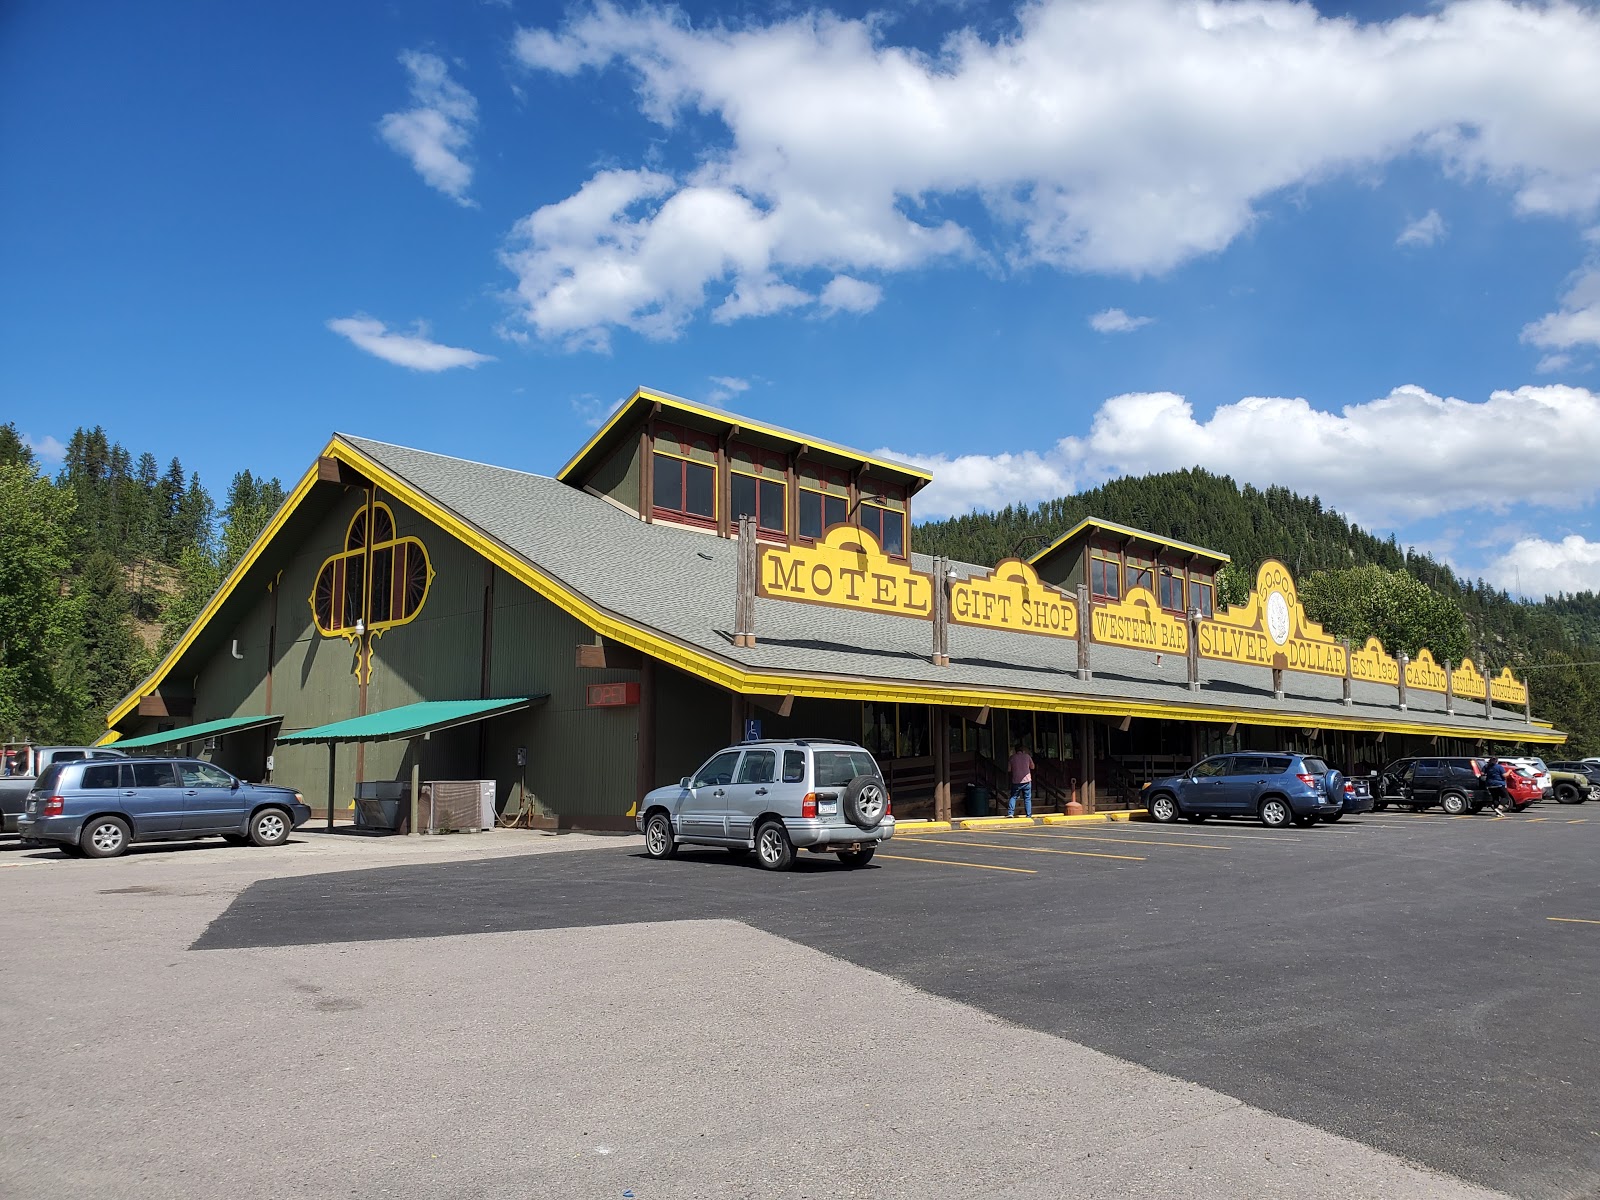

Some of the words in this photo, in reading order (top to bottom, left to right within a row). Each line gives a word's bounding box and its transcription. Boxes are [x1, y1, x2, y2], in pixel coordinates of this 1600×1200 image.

[768, 555, 927, 611] MOTEL
[955, 587, 1011, 623] GIFT
[1021, 599, 1073, 632] SHOP
[1095, 612, 1157, 645] WESTERN
[1161, 623, 1186, 650] BAR
[1200, 623, 1273, 663] SILVER
[1289, 640, 1346, 674] DOLLAR
[1352, 656, 1376, 678] EST.
[1378, 662, 1398, 681] 1952
[1406, 667, 1447, 688] CASINO
